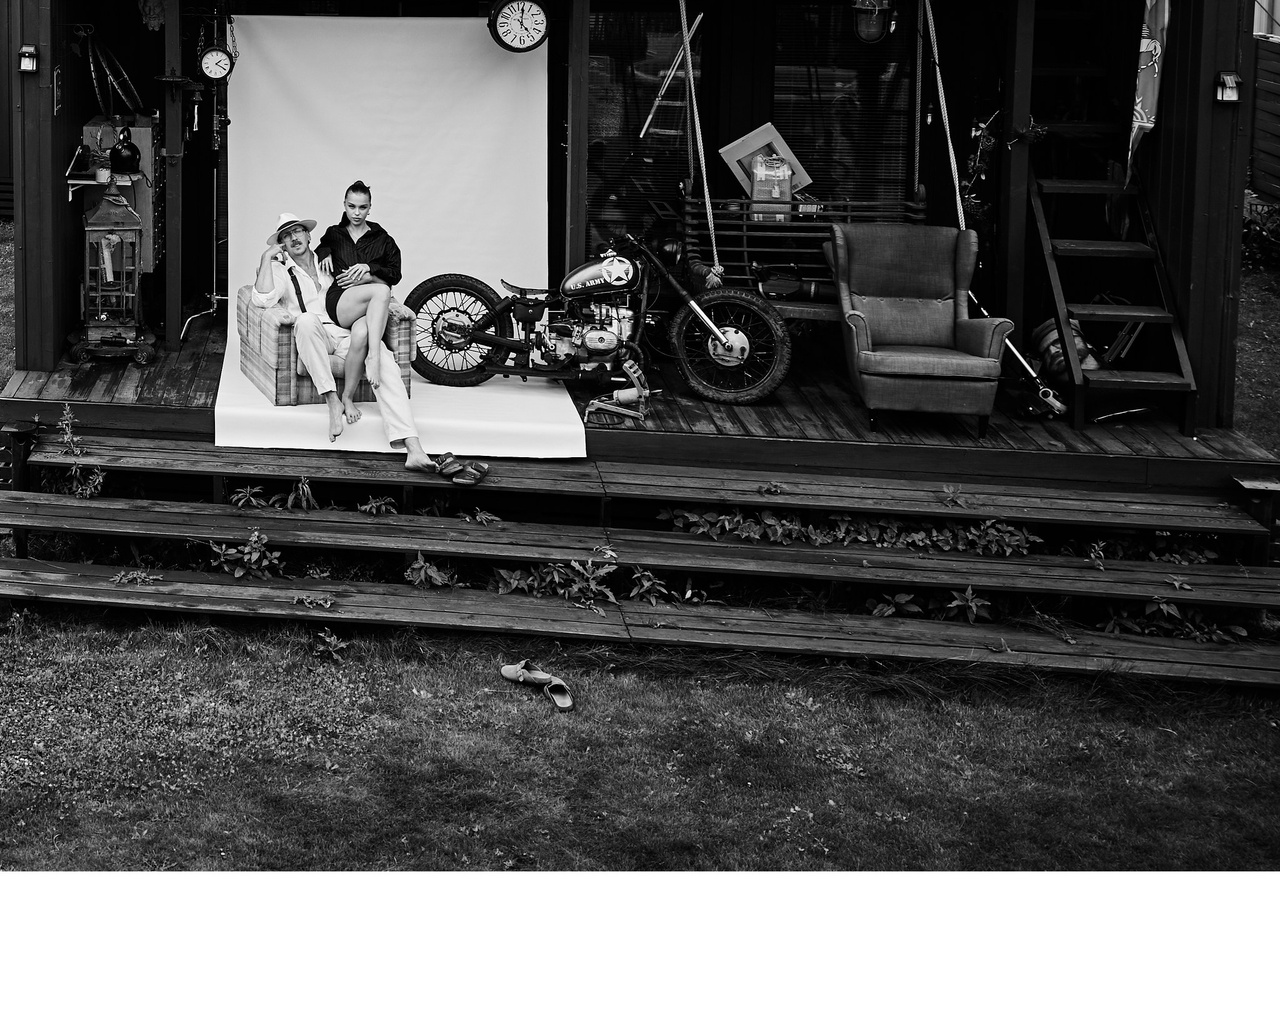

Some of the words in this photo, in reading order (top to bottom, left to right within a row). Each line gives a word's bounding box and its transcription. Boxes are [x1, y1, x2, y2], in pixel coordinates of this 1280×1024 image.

[507, 5, 517, 14] 11
[531, 9, 541, 18] 2
[502, 28, 511, 37] 8
[510, 33, 518, 43] 7
[519, 35, 526, 45] 6
[570, 282, 585, 290] U.S.
[585, 277, 605, 287] ARMY
